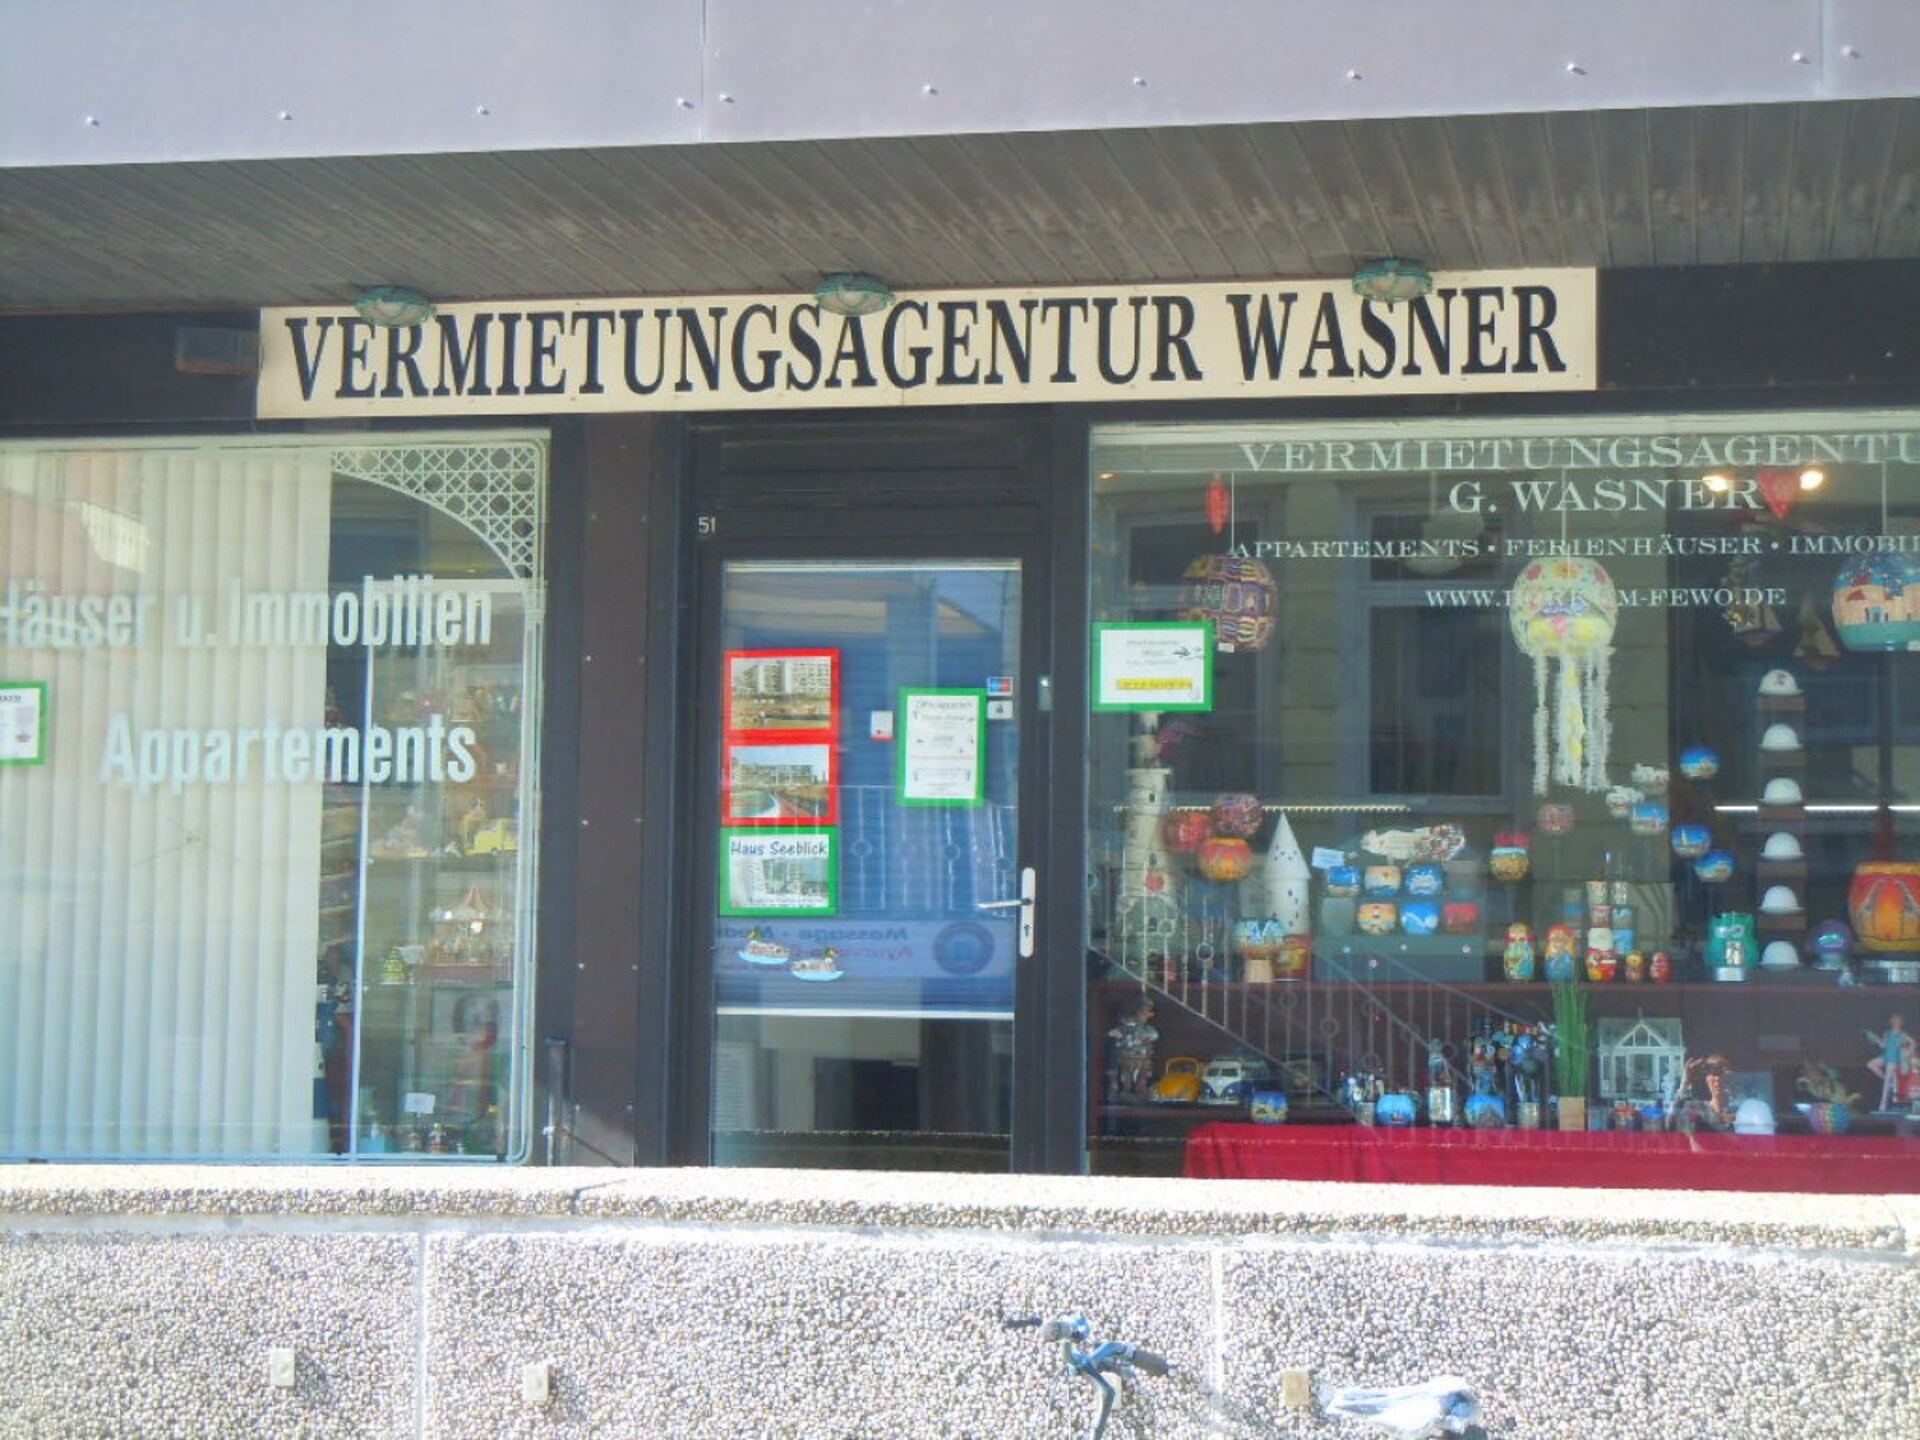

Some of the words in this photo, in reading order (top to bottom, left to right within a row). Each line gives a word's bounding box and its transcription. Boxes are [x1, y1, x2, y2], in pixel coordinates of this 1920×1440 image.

[285, 295, 1203, 400] VERMIETUNGSAGENTUR
[1226, 286, 1566, 381] WASNER
[1449, 480, 1497, 513] G.
[1511, 478, 1764, 513] WASNER
[698, 515, 716, 534] 51
[1233, 538, 1479, 558] APPARTEMENTS
[1505, 533, 1763, 556] FERIENHÄUSER
[176, 590, 218, 647] u.
[230, 575, 493, 646] Immobilien
[100, 712, 477, 798] Appartements
[730, 840, 764, 856] Haus
[769, 840, 828, 856] Seeblick
